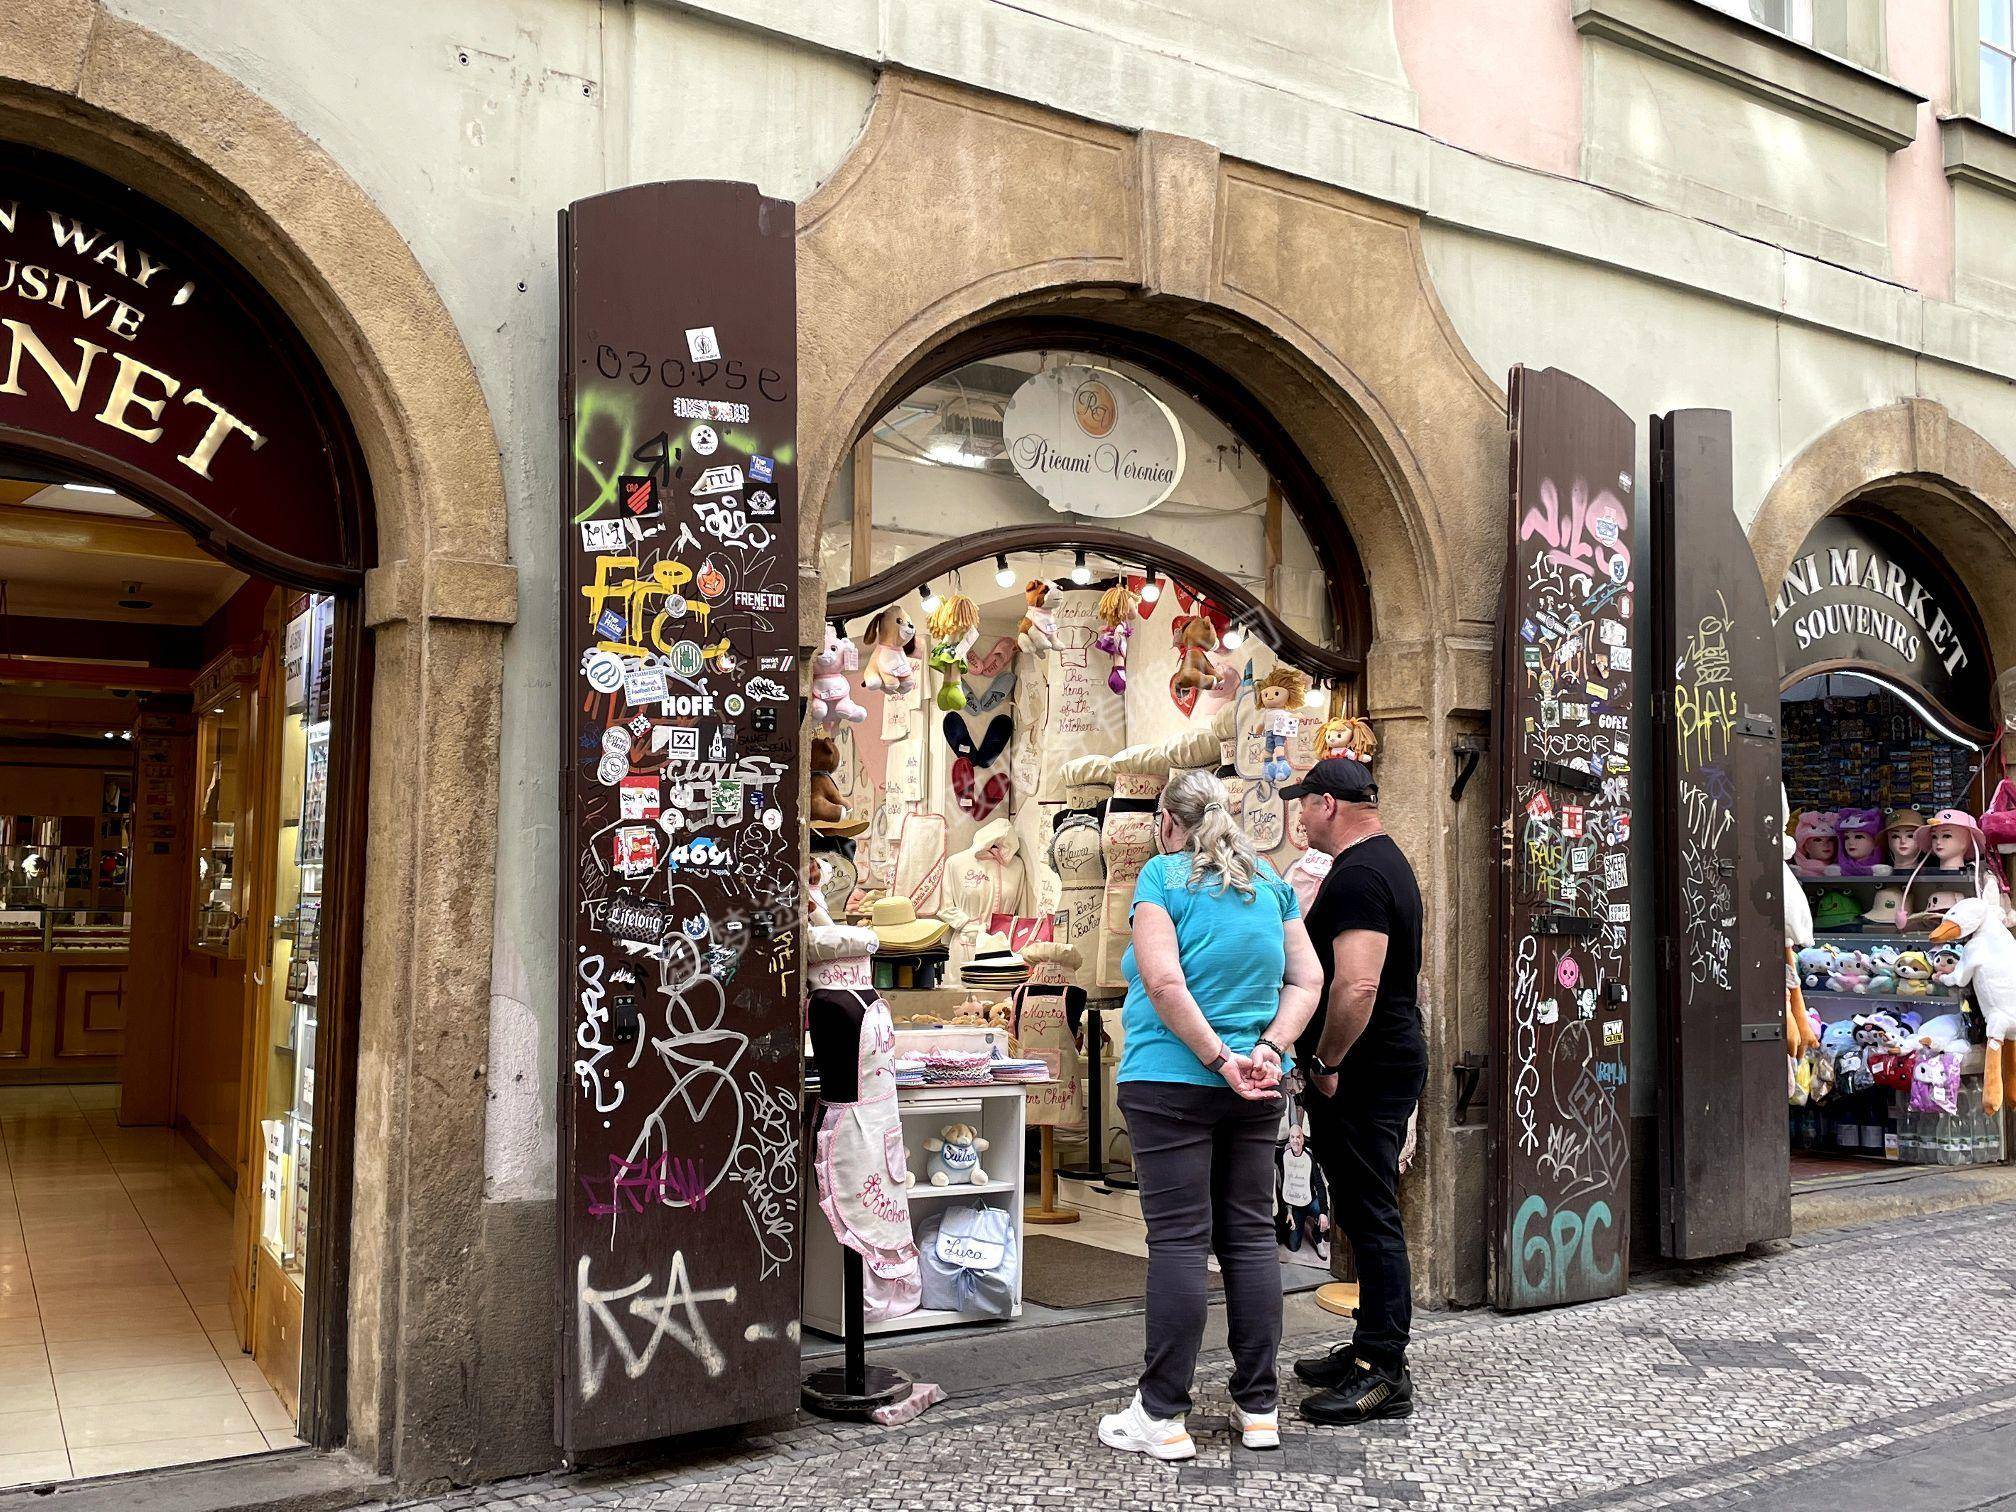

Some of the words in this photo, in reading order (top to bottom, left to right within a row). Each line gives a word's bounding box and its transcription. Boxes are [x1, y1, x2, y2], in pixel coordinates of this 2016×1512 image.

[48, 210, 171, 289] WAY
[0, 318, 269, 482] NET
[1012, 433, 1091, 474] Ricami
[1094, 443, 1175, 485] Veronica
[1772, 553, 1824, 628] INI
[1827, 547, 1968, 677] MARKET
[1794, 603, 1920, 664] SOUVENIRS
[661, 695, 713, 716] HOFF
[606, 908, 662, 933] Lifelong
[946, 1239, 987, 1261] Luca
